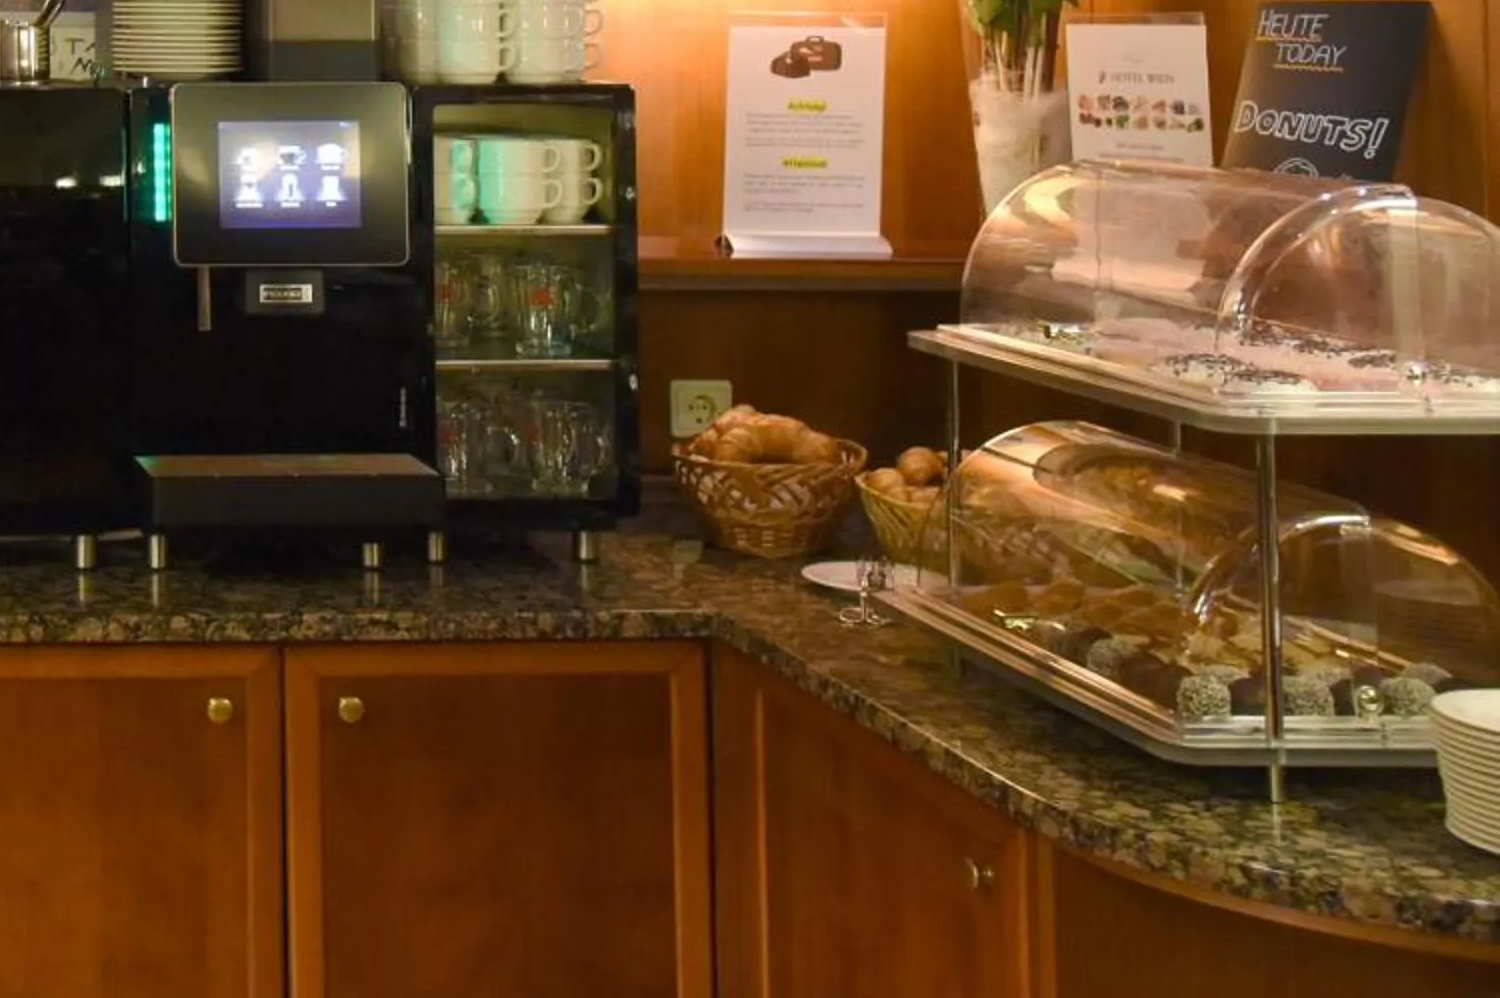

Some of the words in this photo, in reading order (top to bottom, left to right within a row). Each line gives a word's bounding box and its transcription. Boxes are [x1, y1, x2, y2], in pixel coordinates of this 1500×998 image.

[1257, 9, 1329, 37] HEUTE
[1275, 42, 1347, 66] TODAY
[1234, 100, 1389, 160] DONUTS!
